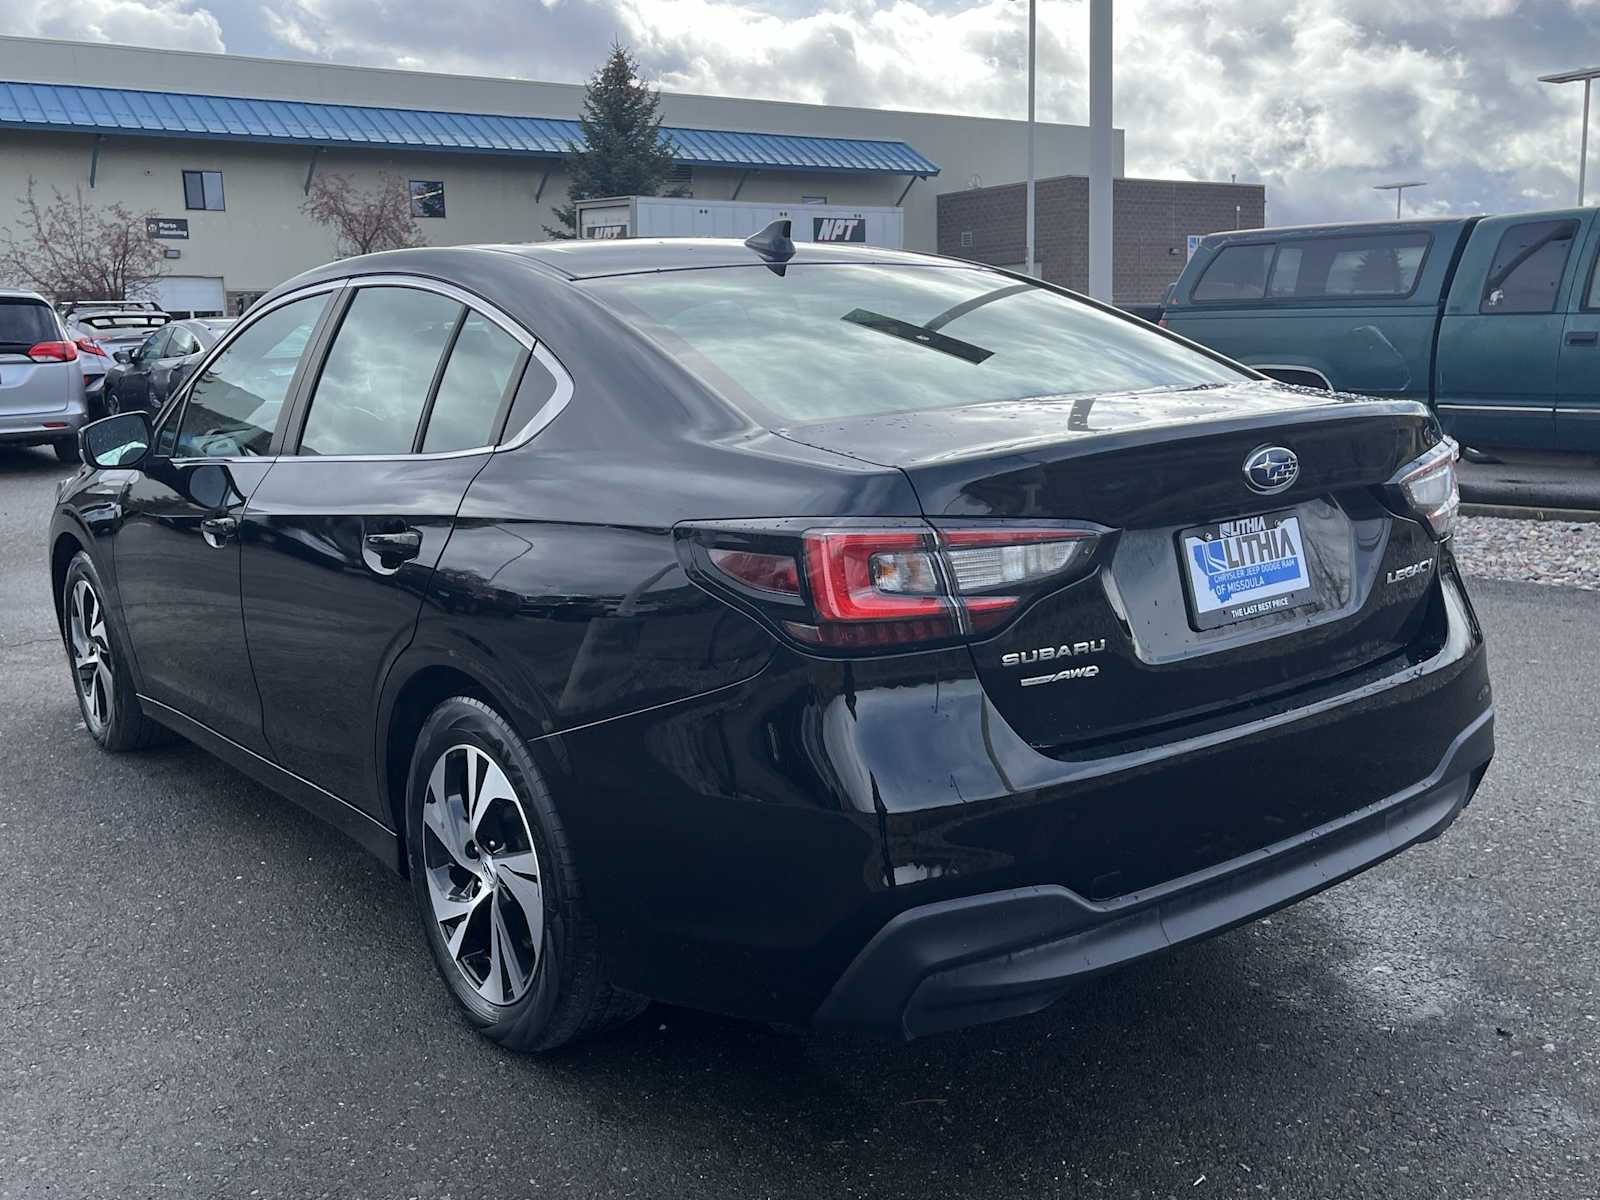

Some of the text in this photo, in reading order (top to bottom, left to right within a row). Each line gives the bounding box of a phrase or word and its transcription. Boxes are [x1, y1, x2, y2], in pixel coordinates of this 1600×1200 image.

[817, 219, 859, 241] NPT
[1229, 516, 1267, 536] LITHIA
[1222, 527, 1297, 569] LITHIA
[1213, 558, 1295, 583] CHRYSLER JEEP DODGE RAM
[1386, 557, 1433, 584] LEGACY
[1216, 575, 1265, 596] OF MISSOULA
[1231, 596, 1289, 618] THE LAST BEST PRICE
[1002, 638, 1105, 667] SUBARU
[1052, 665, 1099, 682] AWD
